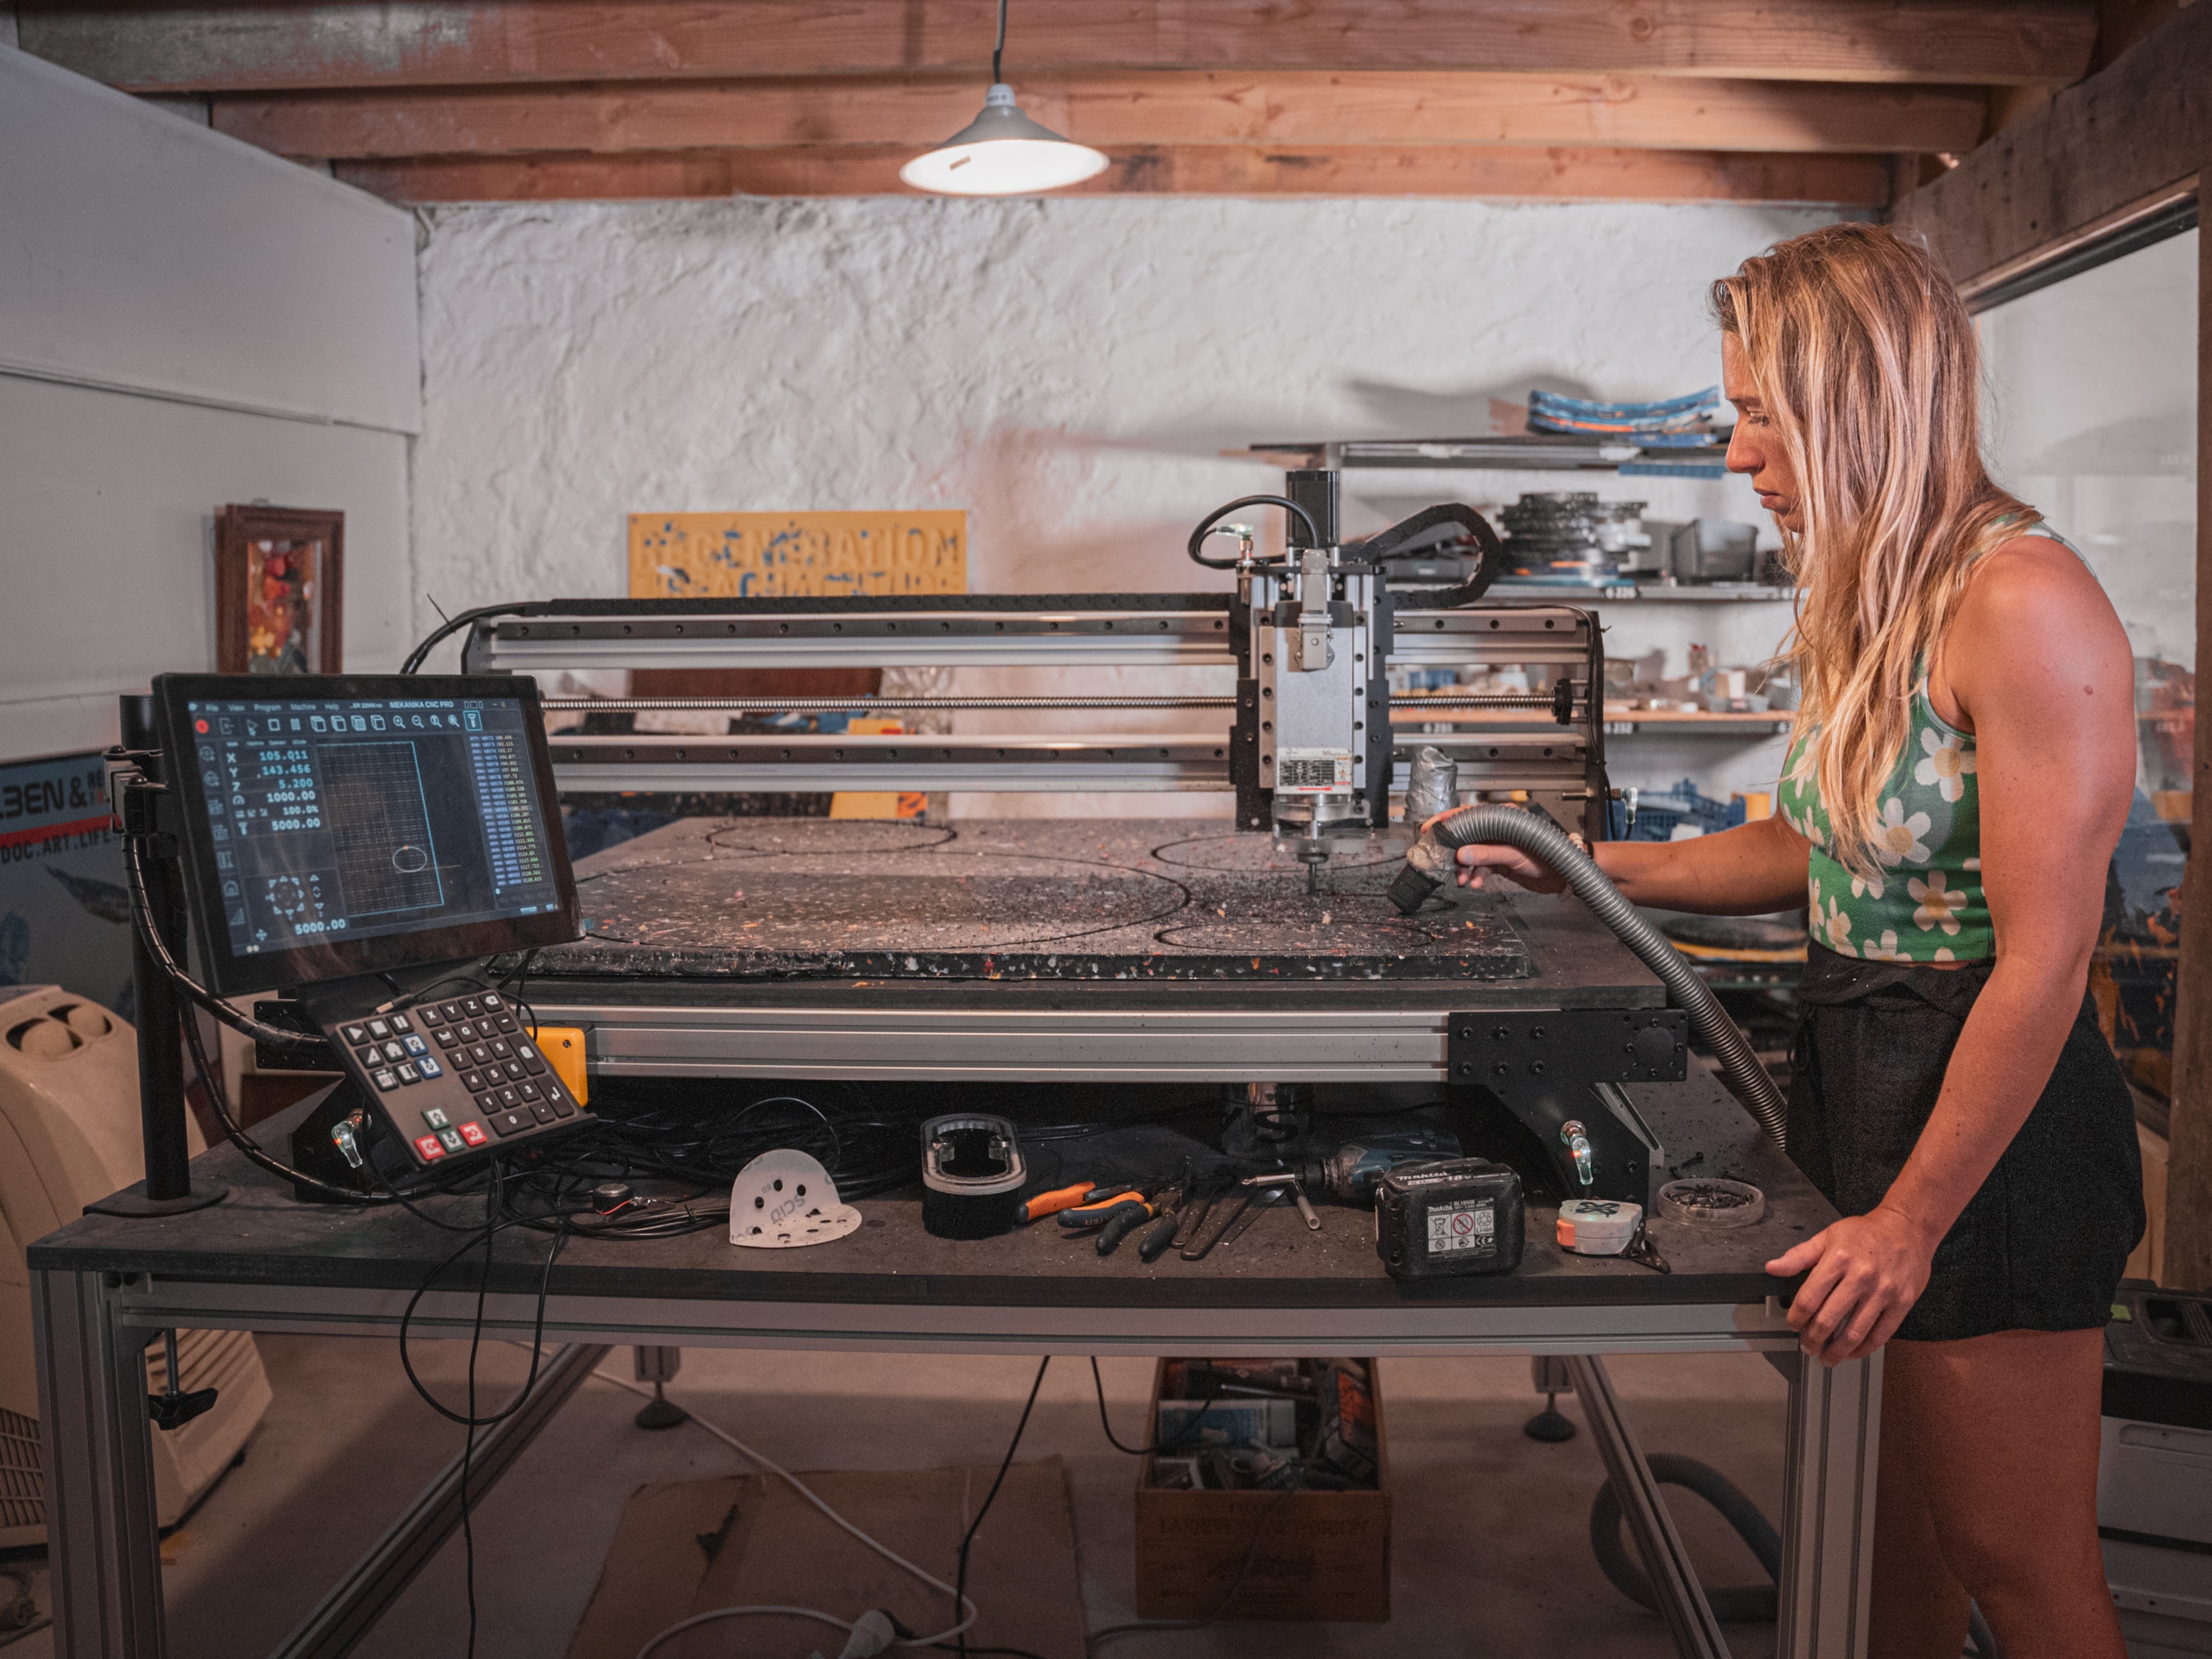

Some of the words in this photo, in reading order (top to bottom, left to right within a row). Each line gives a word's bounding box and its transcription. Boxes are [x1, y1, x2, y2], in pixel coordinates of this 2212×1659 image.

[254, 704, 281, 713] Program
[325, 703, 339, 711] Help
[226, 753, 237, 763] X
[260, 750, 309, 762] 105.011
[229, 767, 238, 778] Y
[262, 763, 311, 776] 143.456
[232, 782, 241, 792] Z
[278, 778, 314, 789] 5.200
[267, 791, 316, 803] 1000.00
[283, 805, 319, 816] 100.0%
[272, 818, 321, 832] 5000.00
[294, 919, 347, 935] 5000.00
[426, 1011, 436, 1020] X
[447, 1006, 455, 1014] Y
[468, 1001, 477, 1010] Z
[461, 1027, 471, 1035] G
[481, 1022, 488, 1030] F
[455, 1053, 462, 1062] 7
[475, 1048, 484, 1057] 8
[496, 1042, 504, 1051] 9
[471, 1075, 479, 1084] 4
[490, 1069, 499, 1078] 5
[510, 1064, 519, 1072] 6
[486, 1097, 493, 1106] 1
[504, 1091, 513, 1100] 2
[524, 1085, 533, 1094] 3
[509, 1115, 517, 1124] 0
